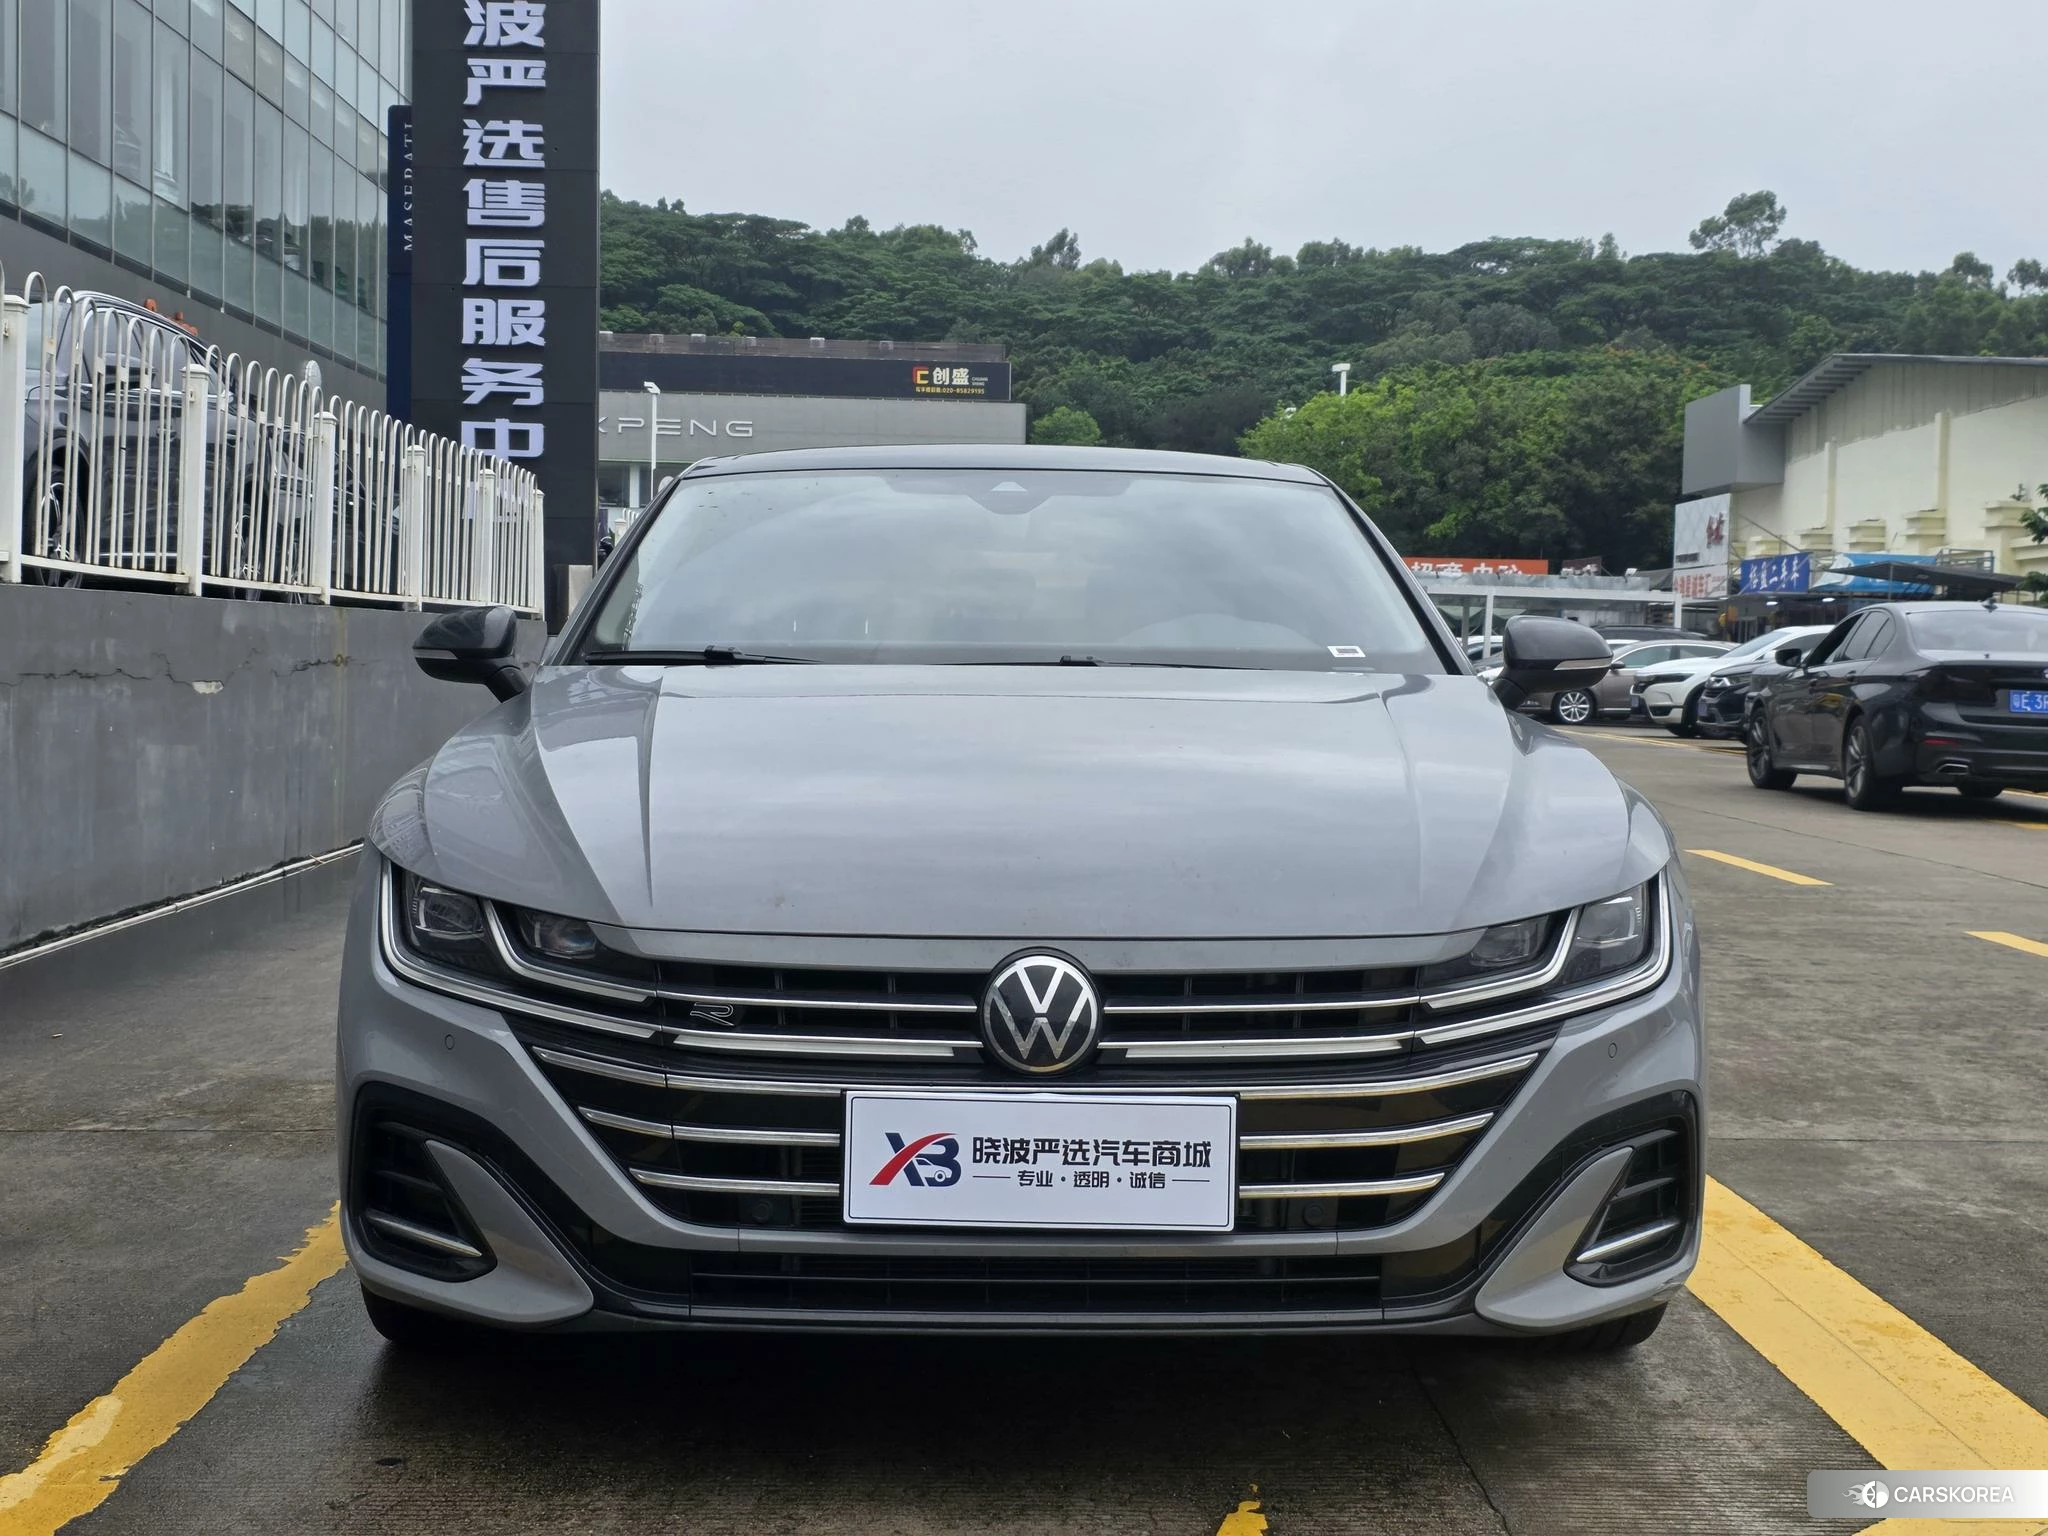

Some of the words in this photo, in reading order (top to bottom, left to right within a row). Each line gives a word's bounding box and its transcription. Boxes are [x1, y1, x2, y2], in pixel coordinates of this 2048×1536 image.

[461, 0, 547, 522] 波严选售后服务中
[932, 367, 970, 385] 创盛
[972, 1136, 1212, 1168] 晓波严选汽车商城
